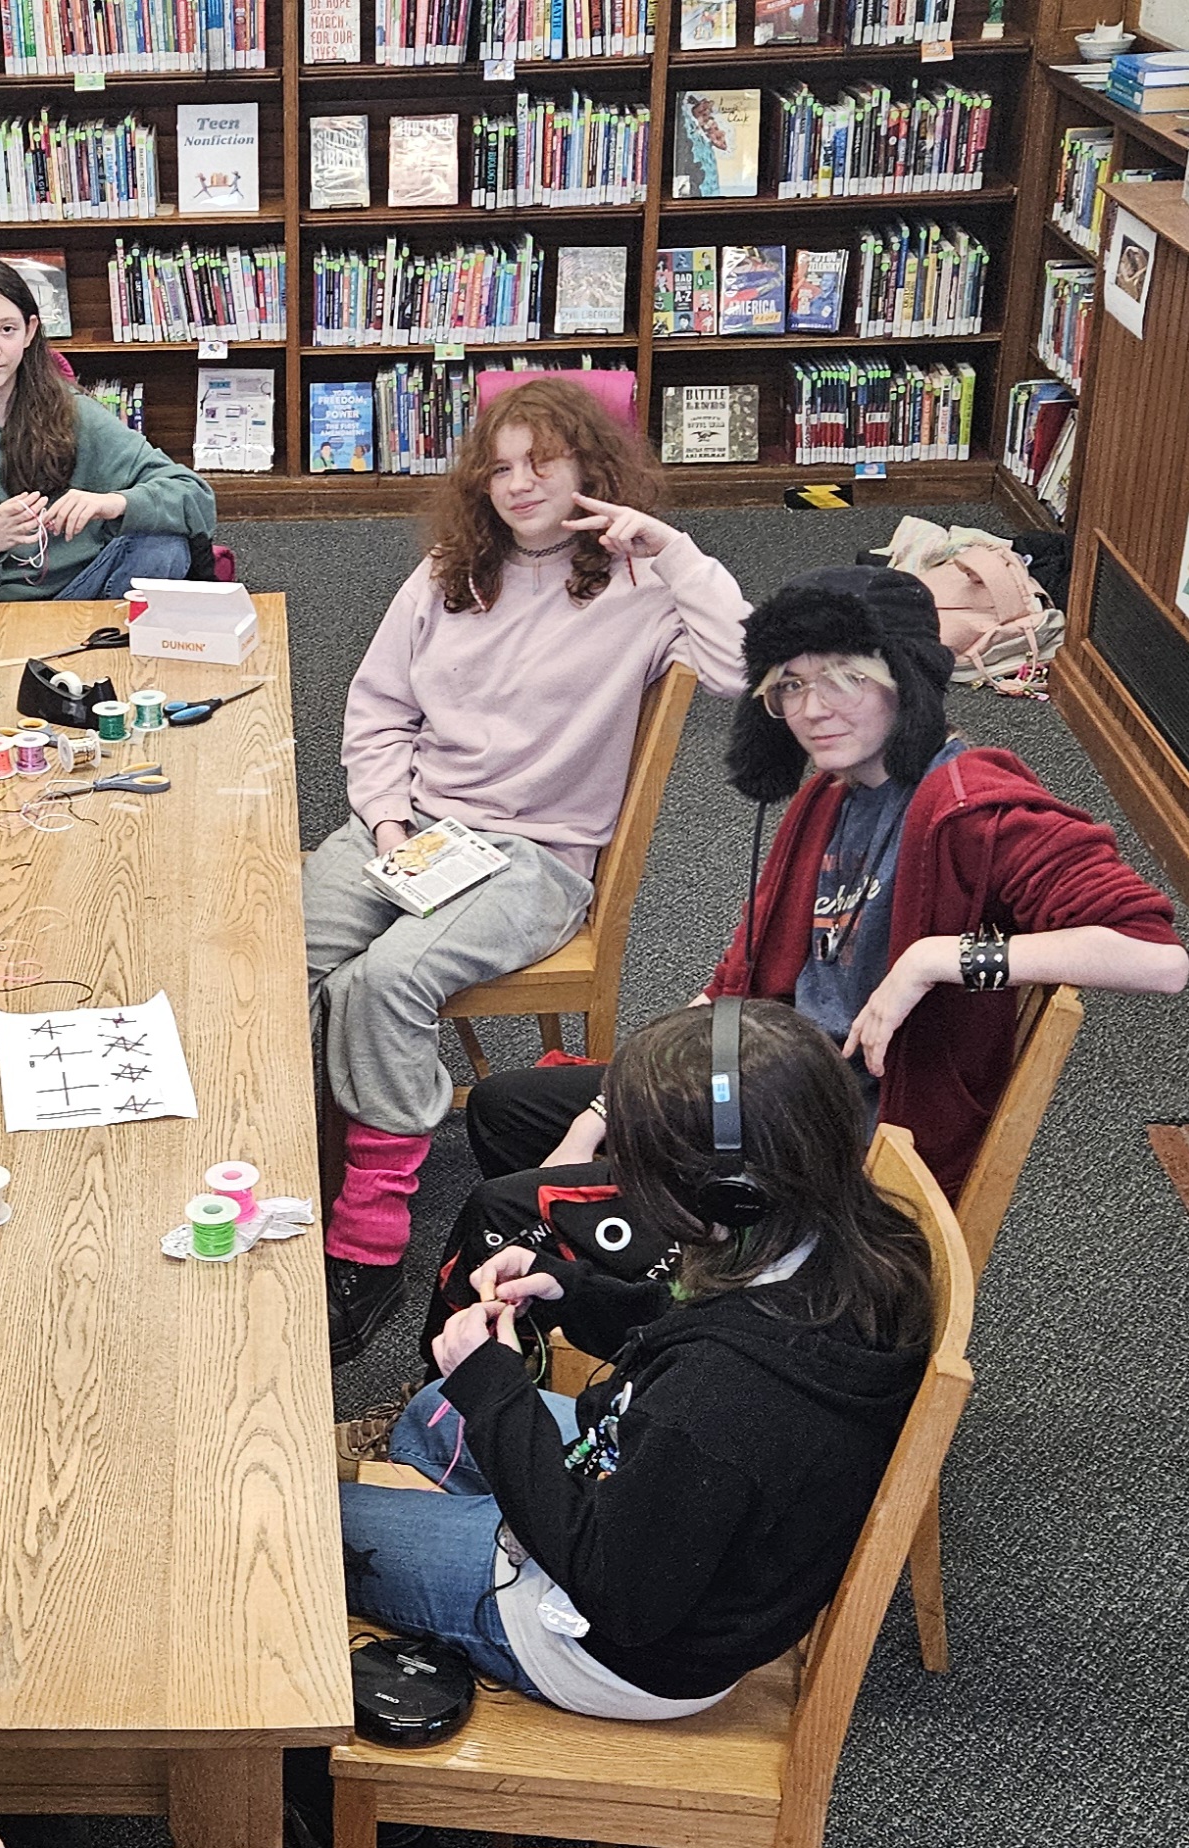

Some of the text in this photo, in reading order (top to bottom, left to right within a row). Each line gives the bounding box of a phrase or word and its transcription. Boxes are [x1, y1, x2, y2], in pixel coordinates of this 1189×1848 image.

[311, 15, 344, 29] MARCH
[311, 30, 353, 44] FOR OUR
[197, 118, 240, 130] Teen
[184, 134, 254, 146] Nonfiction
[488, 151, 498, 187] BIOLOGY
[729, 300, 776, 315] AMERICA
[318, 396, 367, 405] FREEDOM,
[686, 388, 726, 401] BATTLE
[686, 402, 726, 410] LINES
[325, 410, 359, 419] POWER
[161, 640, 206, 652] DUNKIN'
